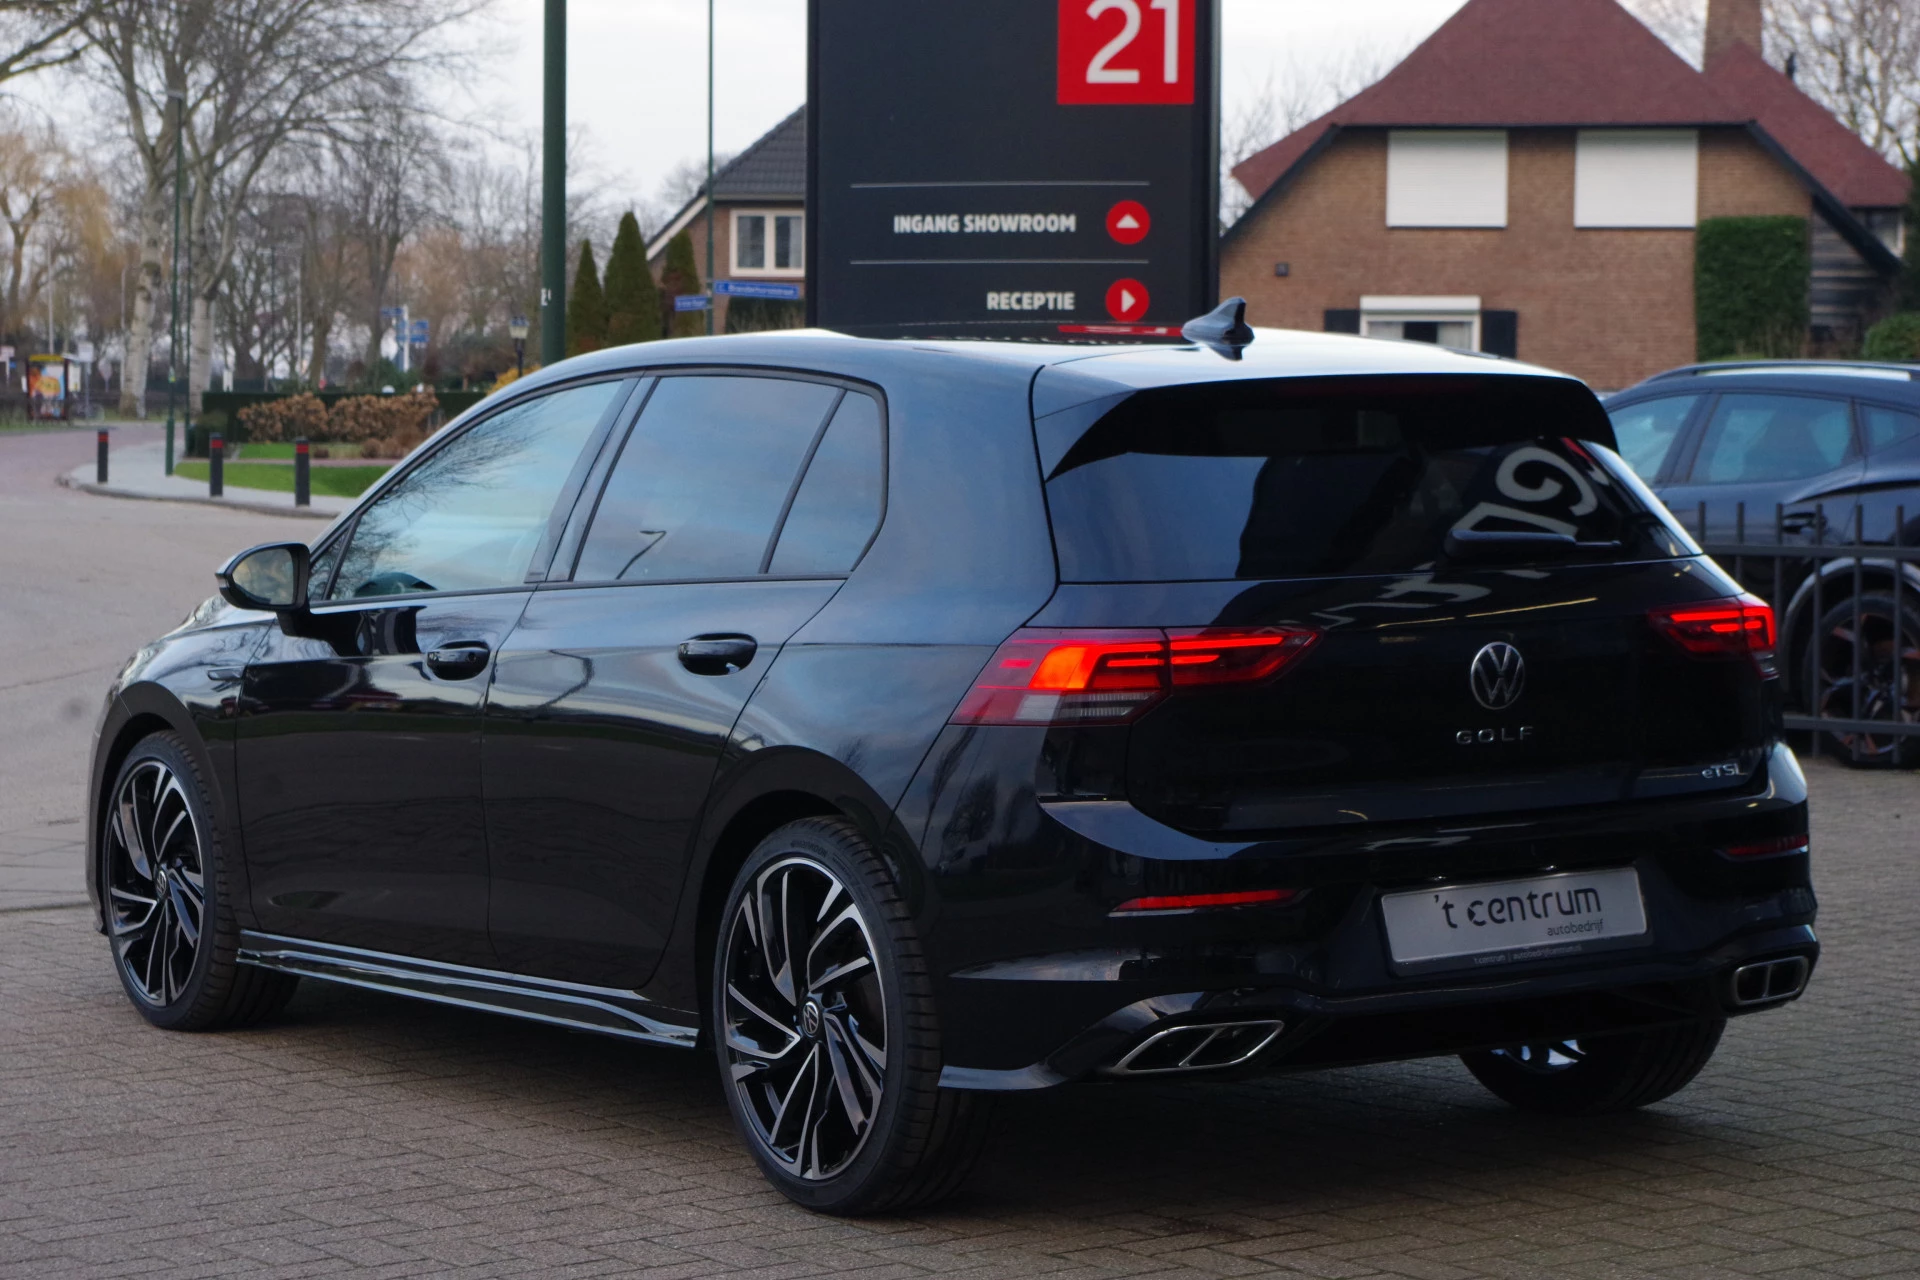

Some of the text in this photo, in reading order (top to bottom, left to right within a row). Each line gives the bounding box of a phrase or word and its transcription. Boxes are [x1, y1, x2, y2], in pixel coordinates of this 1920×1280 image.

[1086, 0, 1178, 84] 21
[893, 213, 1077, 234] INGANG SHOWROOM
[986, 291, 1075, 310] RECEPTIE
[1456, 725, 1534, 745] GOLF
[1467, 887, 1602, 927] centrum
[1547, 918, 1604, 937] autobedrijf
